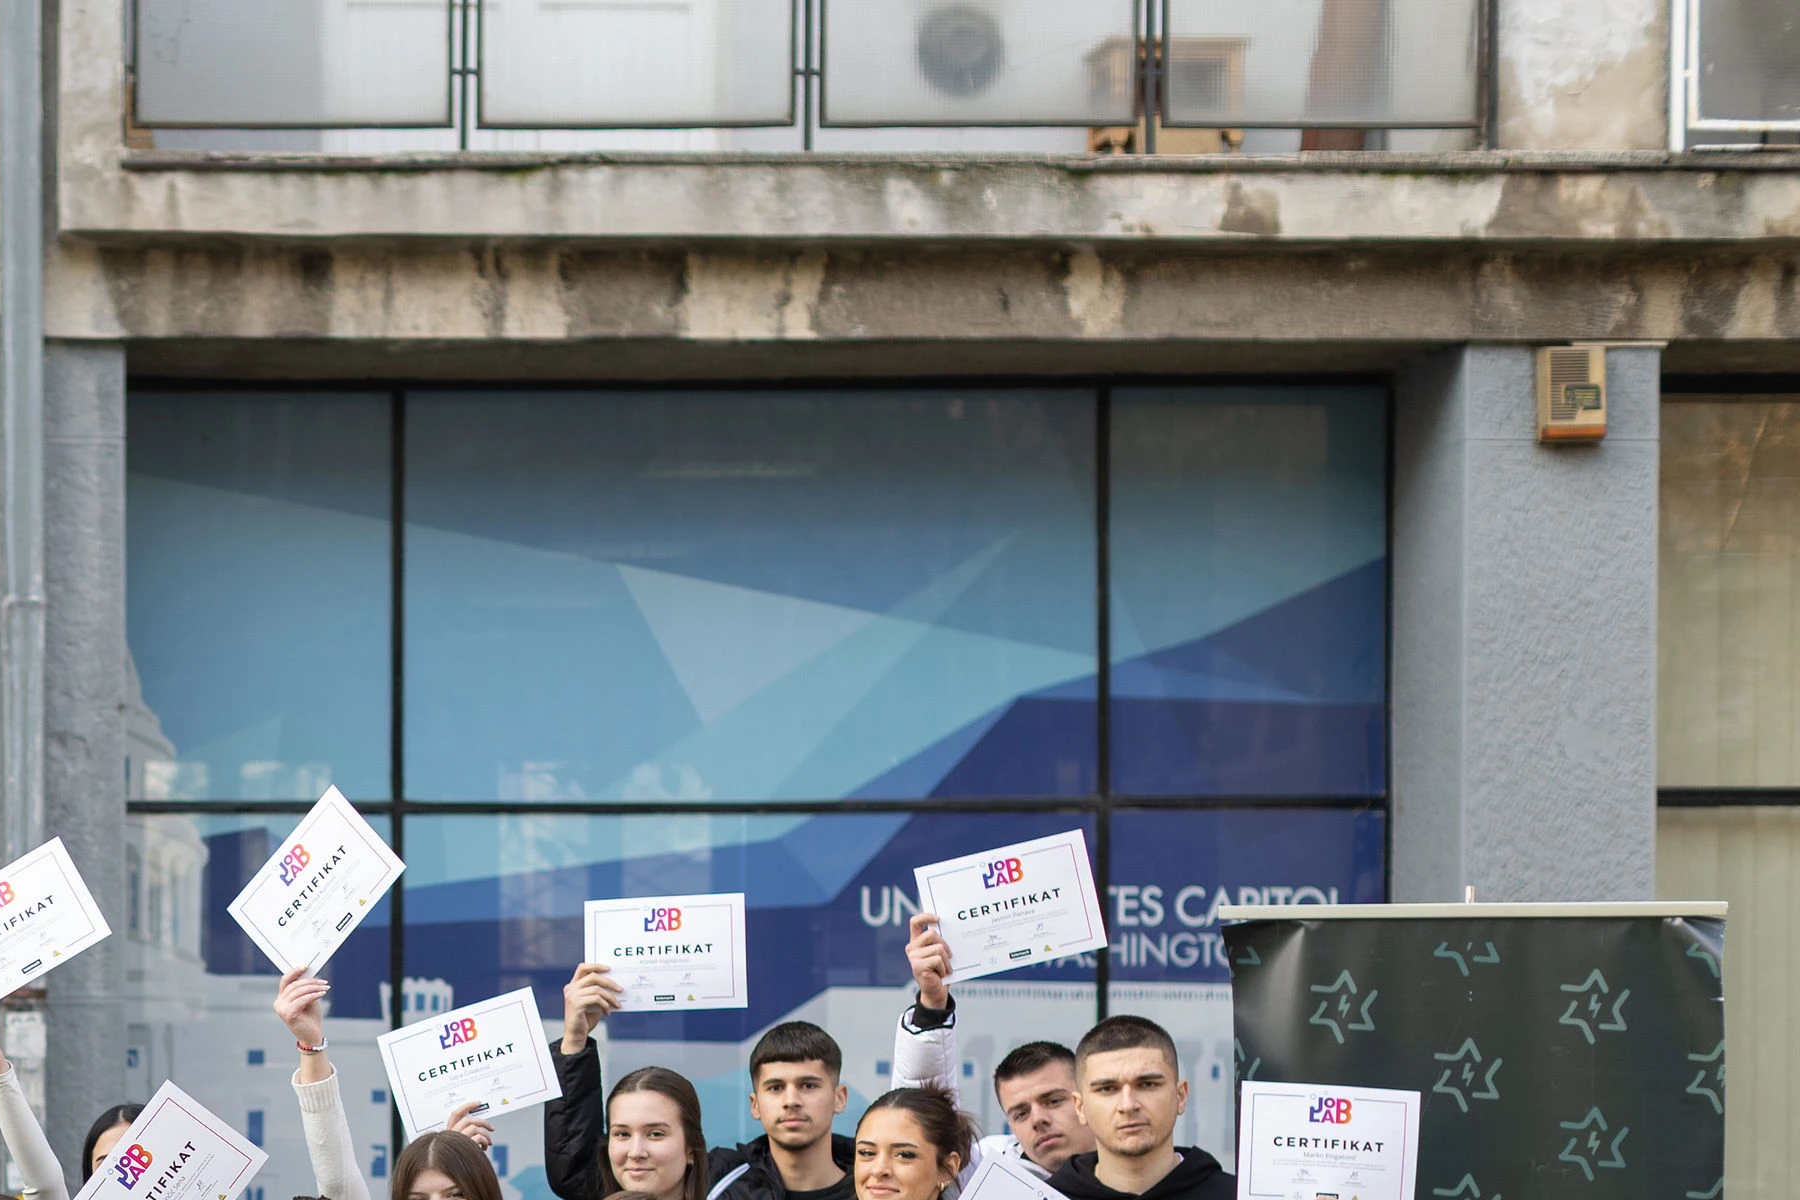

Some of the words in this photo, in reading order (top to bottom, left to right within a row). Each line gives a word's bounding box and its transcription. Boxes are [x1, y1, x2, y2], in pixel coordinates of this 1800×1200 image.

[279, 848, 311, 887] LAB
[982, 865, 1023, 888] LAB
[278, 845, 347, 927] CERTIFIKAT
[957, 888, 1061, 920] CERTIFIKAT
[644, 915, 681, 931] LAB
[614, 944, 713, 957] CERTIFIKAT
[439, 1024, 477, 1048] LAB
[418, 1043, 515, 1082] CERTIFIKAT
[1309, 1106, 1351, 1123] LAB
[1274, 1136, 1384, 1153] CERTIFIKAT
[117, 1149, 152, 1189] LAB
